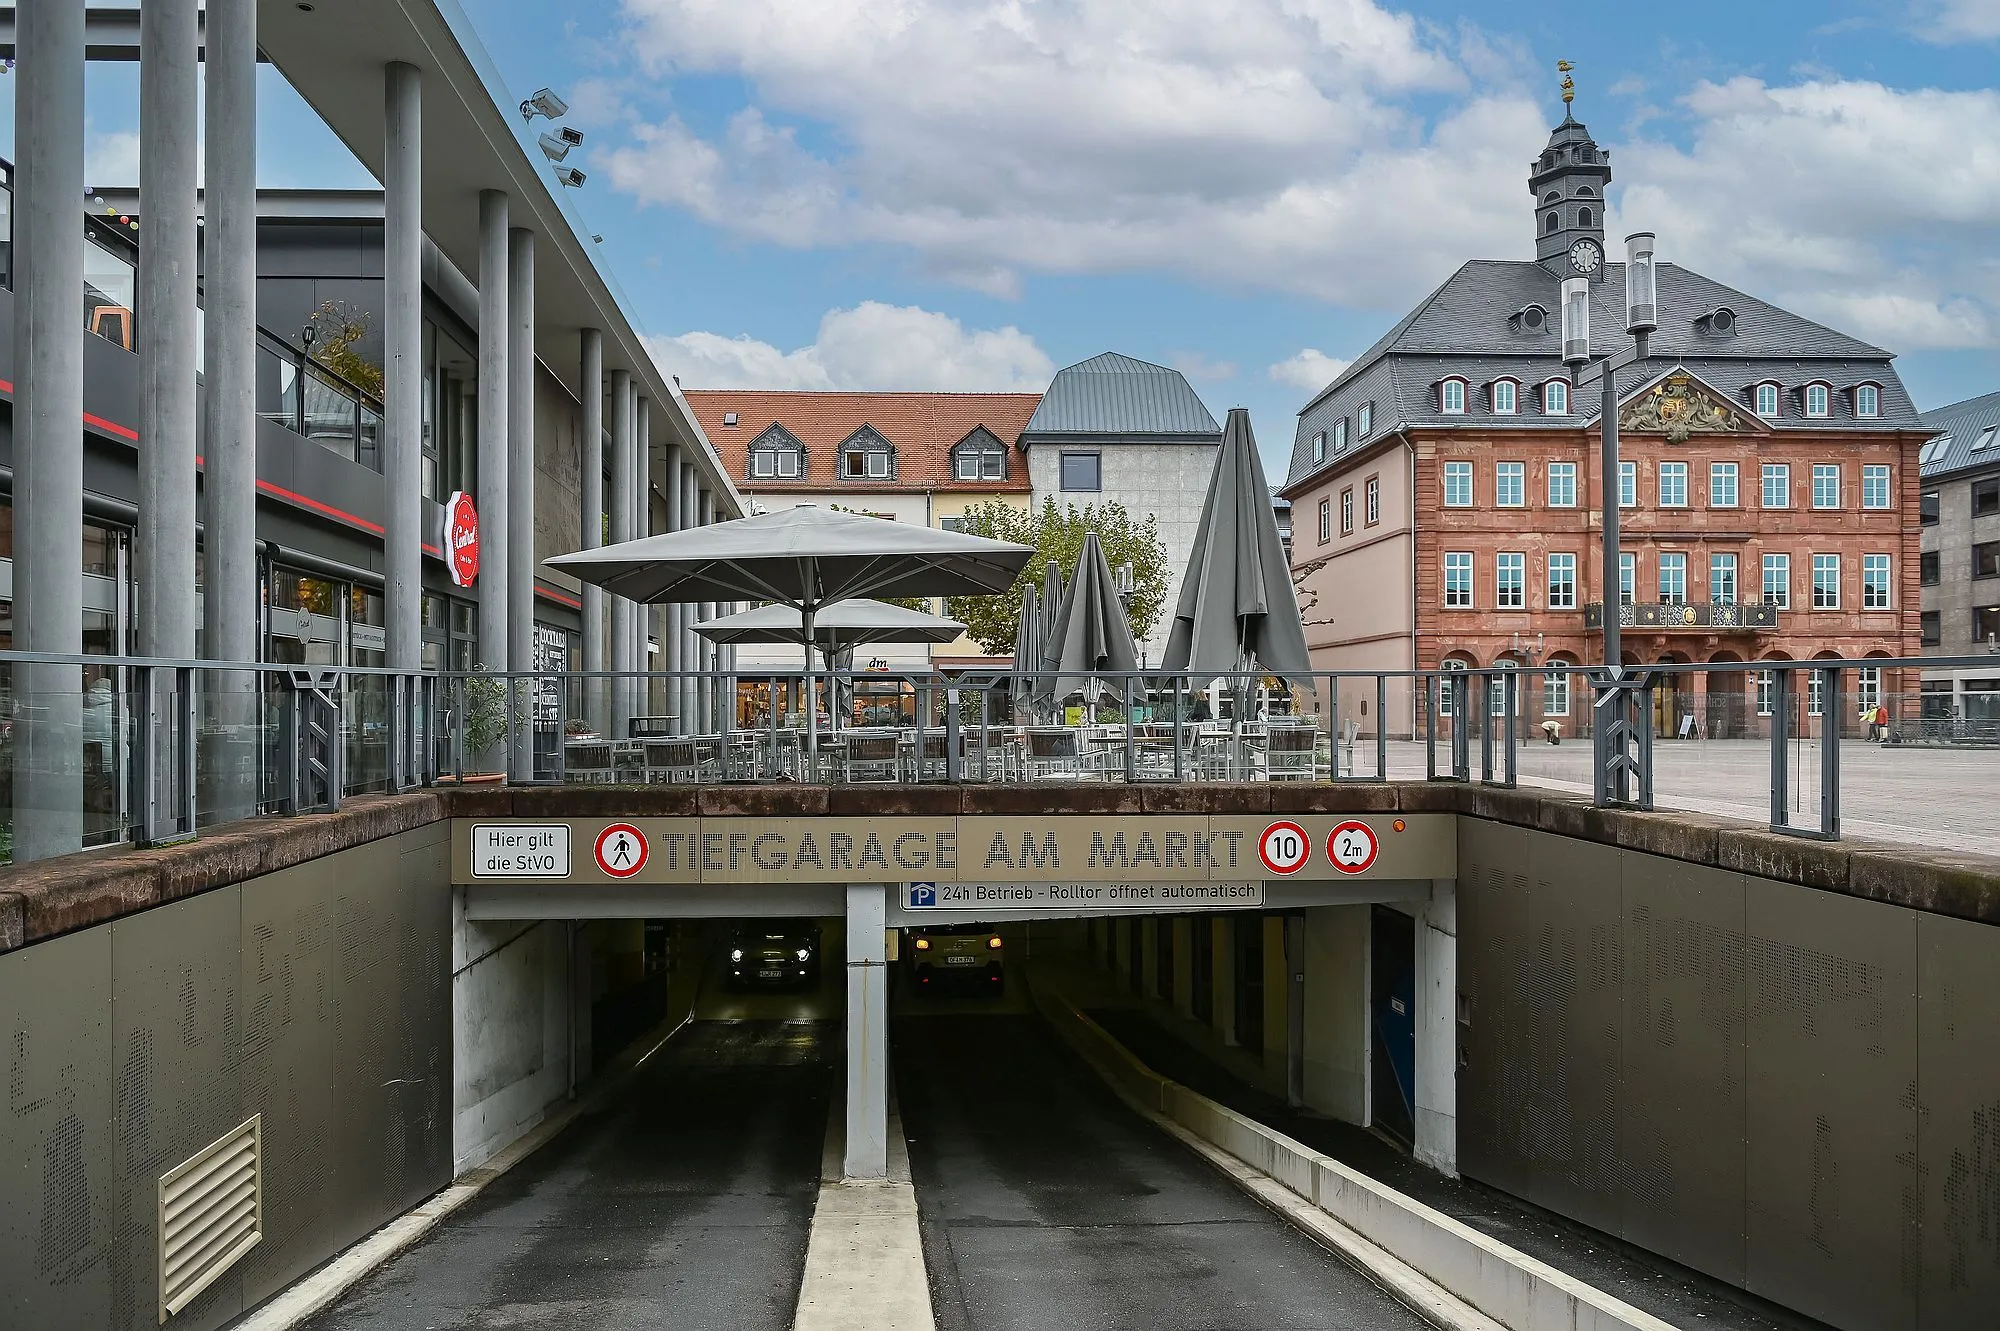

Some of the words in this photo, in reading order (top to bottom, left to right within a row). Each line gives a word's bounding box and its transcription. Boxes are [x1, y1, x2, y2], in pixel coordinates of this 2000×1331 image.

[869, 658, 887, 668] dm
[489, 832, 523, 847] Hier
[528, 832, 553, 850] gilt
[662, 833, 955, 869] TIEFGARAGE
[983, 831, 1060, 868] AM
[1087, 831, 1244, 868] MARKT
[1273, 836, 1296, 859] 10
[1341, 838, 1362, 857] 2m
[487, 855, 511, 871] die
[516, 855, 555, 871] StVO
[942, 885, 970, 900] 24h
[976, 884, 1033, 900] Betrieb
[1050, 883, 1102, 900] Rolltor
[1109, 883, 1155, 899] öffnet
[1161, 883, 1256, 899] automatisch
